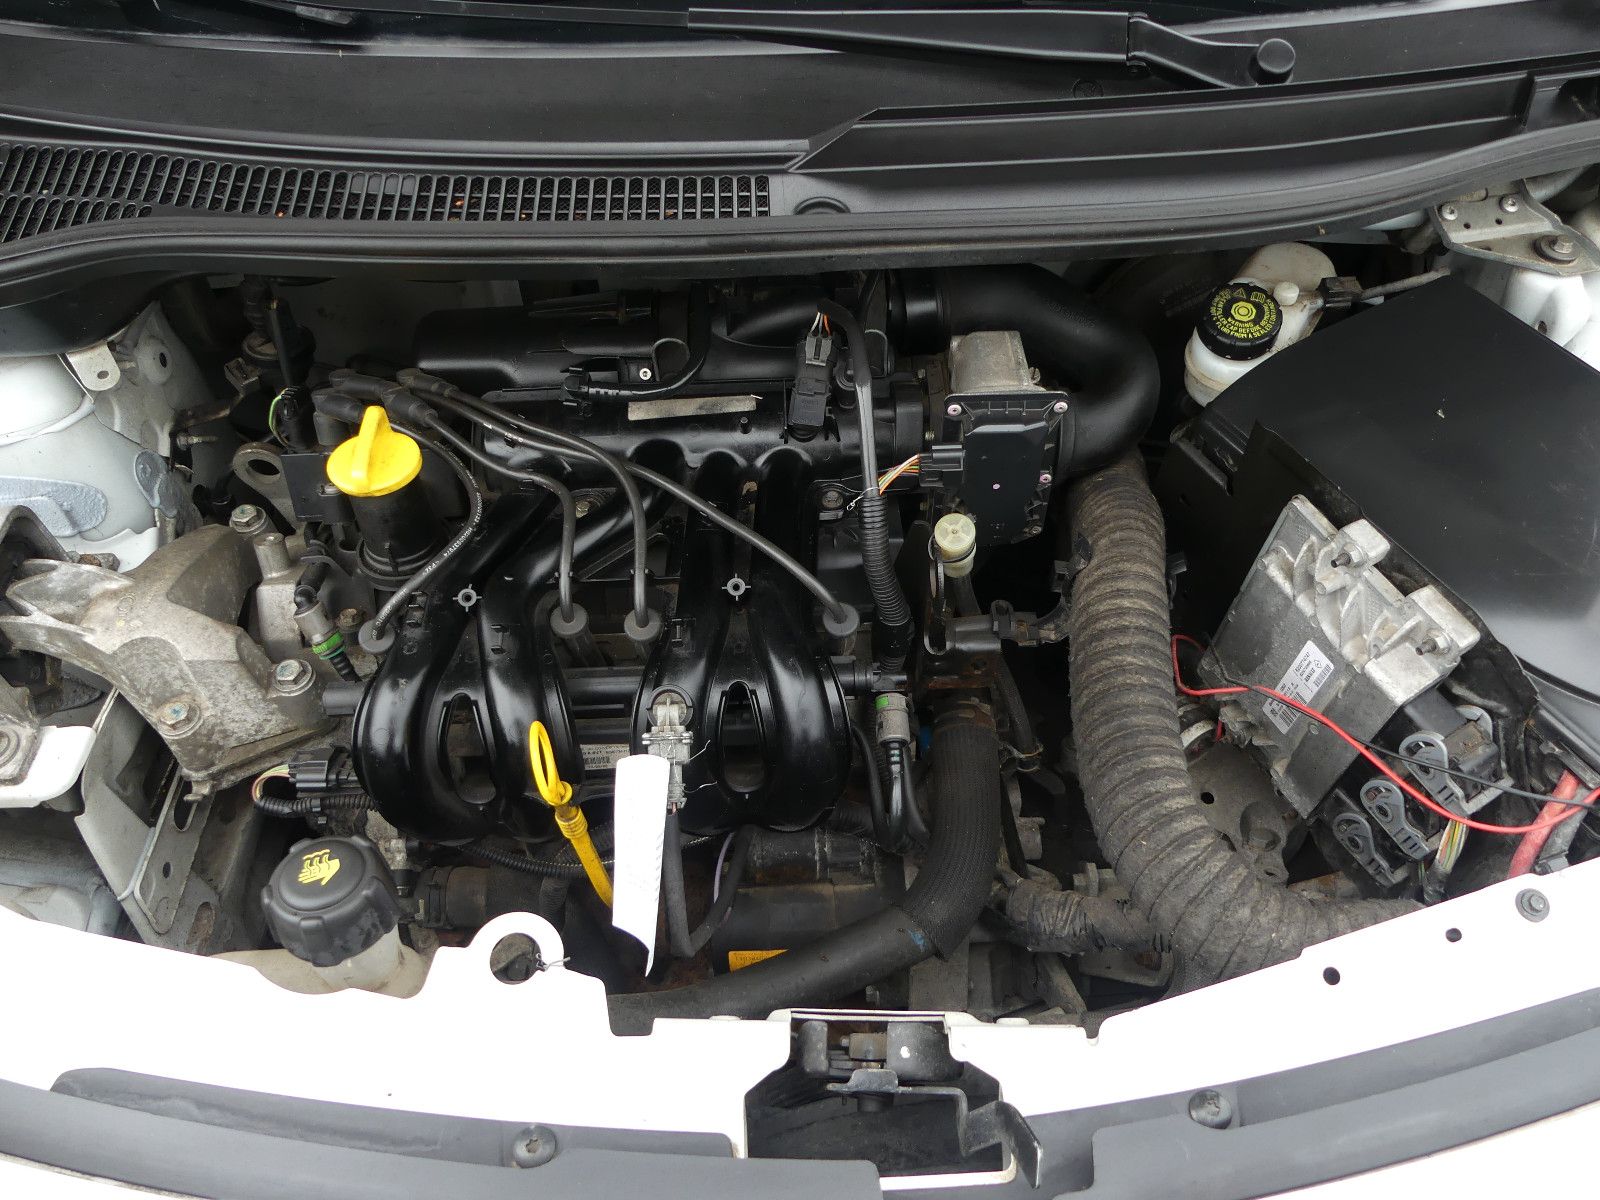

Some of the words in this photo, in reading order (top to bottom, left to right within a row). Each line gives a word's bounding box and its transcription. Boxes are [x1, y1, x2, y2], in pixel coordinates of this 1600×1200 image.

[1215, 321, 1230, 334] FLUID
[1253, 323, 1273, 338] SEALED
[1266, 299, 1276, 324] CONTAINER
[1217, 307, 1228, 325] FILLER
[1226, 323, 1238, 332] CAP
[1238, 324, 1261, 334] BEFORE
[1260, 303, 1271, 327] REMOVING
[1227, 316, 1254, 328] WARNING
